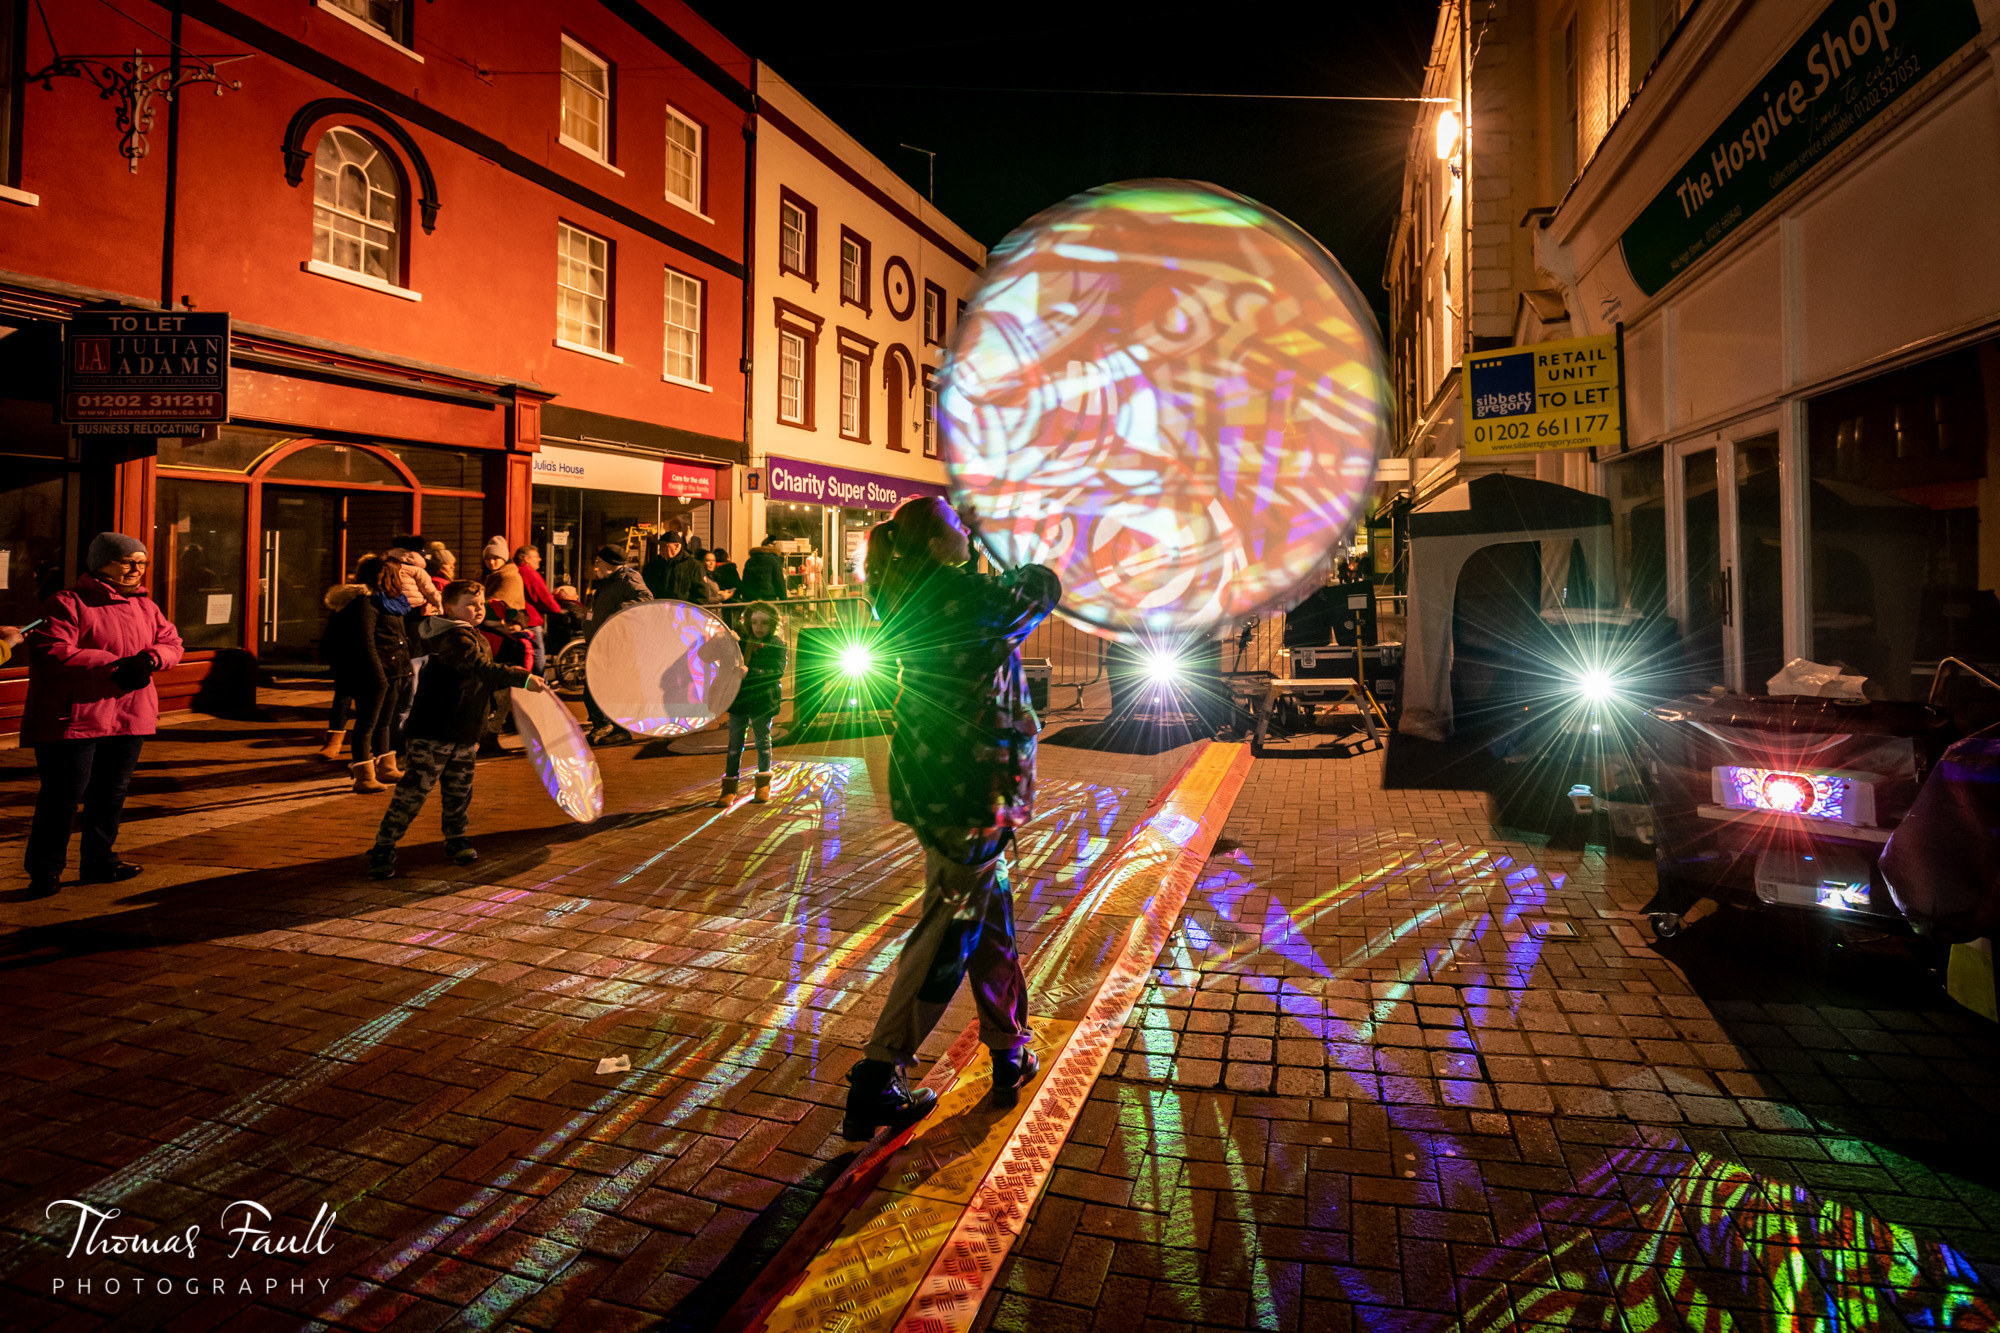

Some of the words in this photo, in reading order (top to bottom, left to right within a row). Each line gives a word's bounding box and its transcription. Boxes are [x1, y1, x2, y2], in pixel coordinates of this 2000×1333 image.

[1676, 171, 1714, 219] The
[1711, 79, 1805, 188] Hospice
[1806, 0, 1897, 98] Shop
[1768, 160, 1800, 189] Collection
[1798, 139, 1822, 166] service
[1822, 113, 1855, 147] available
[1854, 88, 1882, 119] 01202
[1879, 54, 1922, 98] 527052
[108, 316, 139, 332] TO
[145, 316, 187, 332] LET
[117, 338, 220, 355] JULIAN
[117, 356, 219, 375] ADAMS
[1538, 348, 1607, 367] RETAIL
[1548, 365, 1598, 381] UNIT
[77, 394, 142, 407] 01202
[150, 394, 214, 407] 311211
[1476, 391, 1532, 407] sibbett
[1538, 391, 1567, 408] TO
[1574, 387, 1610, 405] LET
[77, 408, 213, 418] www.julianadams.co.uk
[1476, 400, 1532, 417] gregory
[77, 424, 130, 435] BUSINESS
[133, 424, 201, 435] RELOCATING
[1474, 421, 1531, 443] 01202
[1536, 413, 1610, 437] 661177
[1491, 436, 1592, 451] www.sibbettgregory.com
[533, 459, 557, 472] Julia's
[559, 462, 585, 475] House
[671, 474, 683, 482] Care
[690, 476, 698, 484] the
[771, 467, 825, 500] Charity
[828, 476, 866, 503] Super
[867, 482, 897, 504] Store
